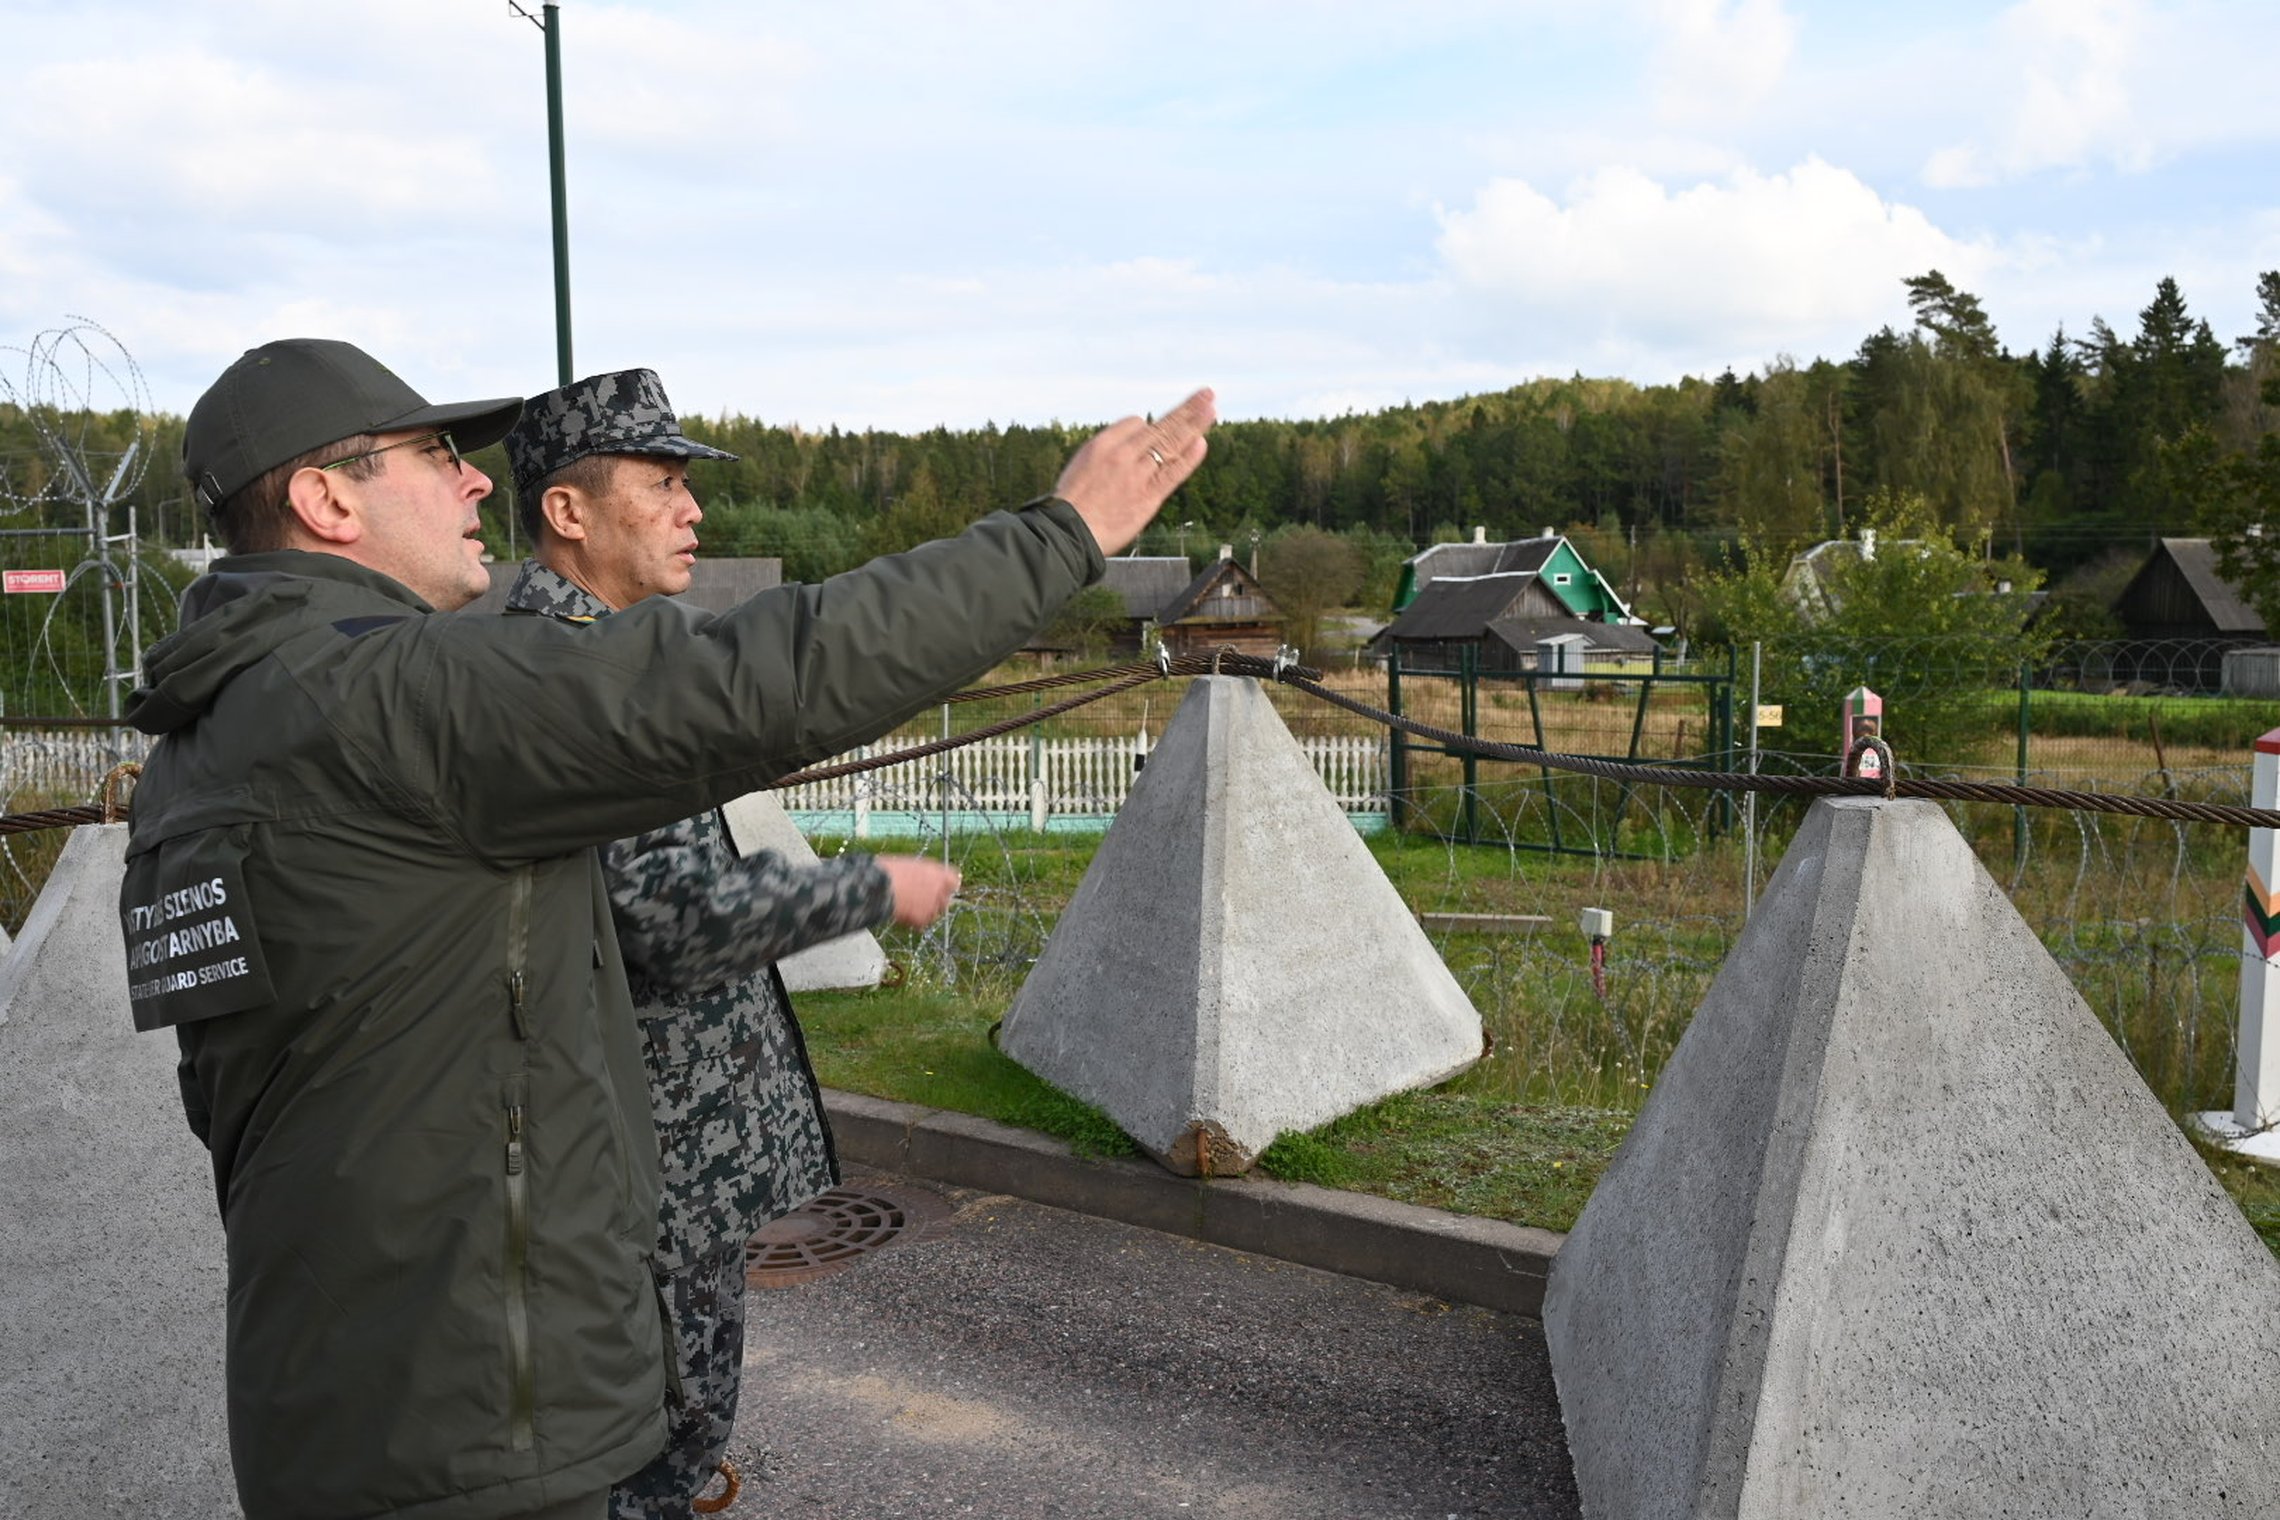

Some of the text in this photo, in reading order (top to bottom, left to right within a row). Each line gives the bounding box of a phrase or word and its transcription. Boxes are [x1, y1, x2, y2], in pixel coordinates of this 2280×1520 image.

[8, 573, 59, 585] STORENT
[164, 877, 227, 920] SIENOS
[198, 956, 249, 986] SERVICE
